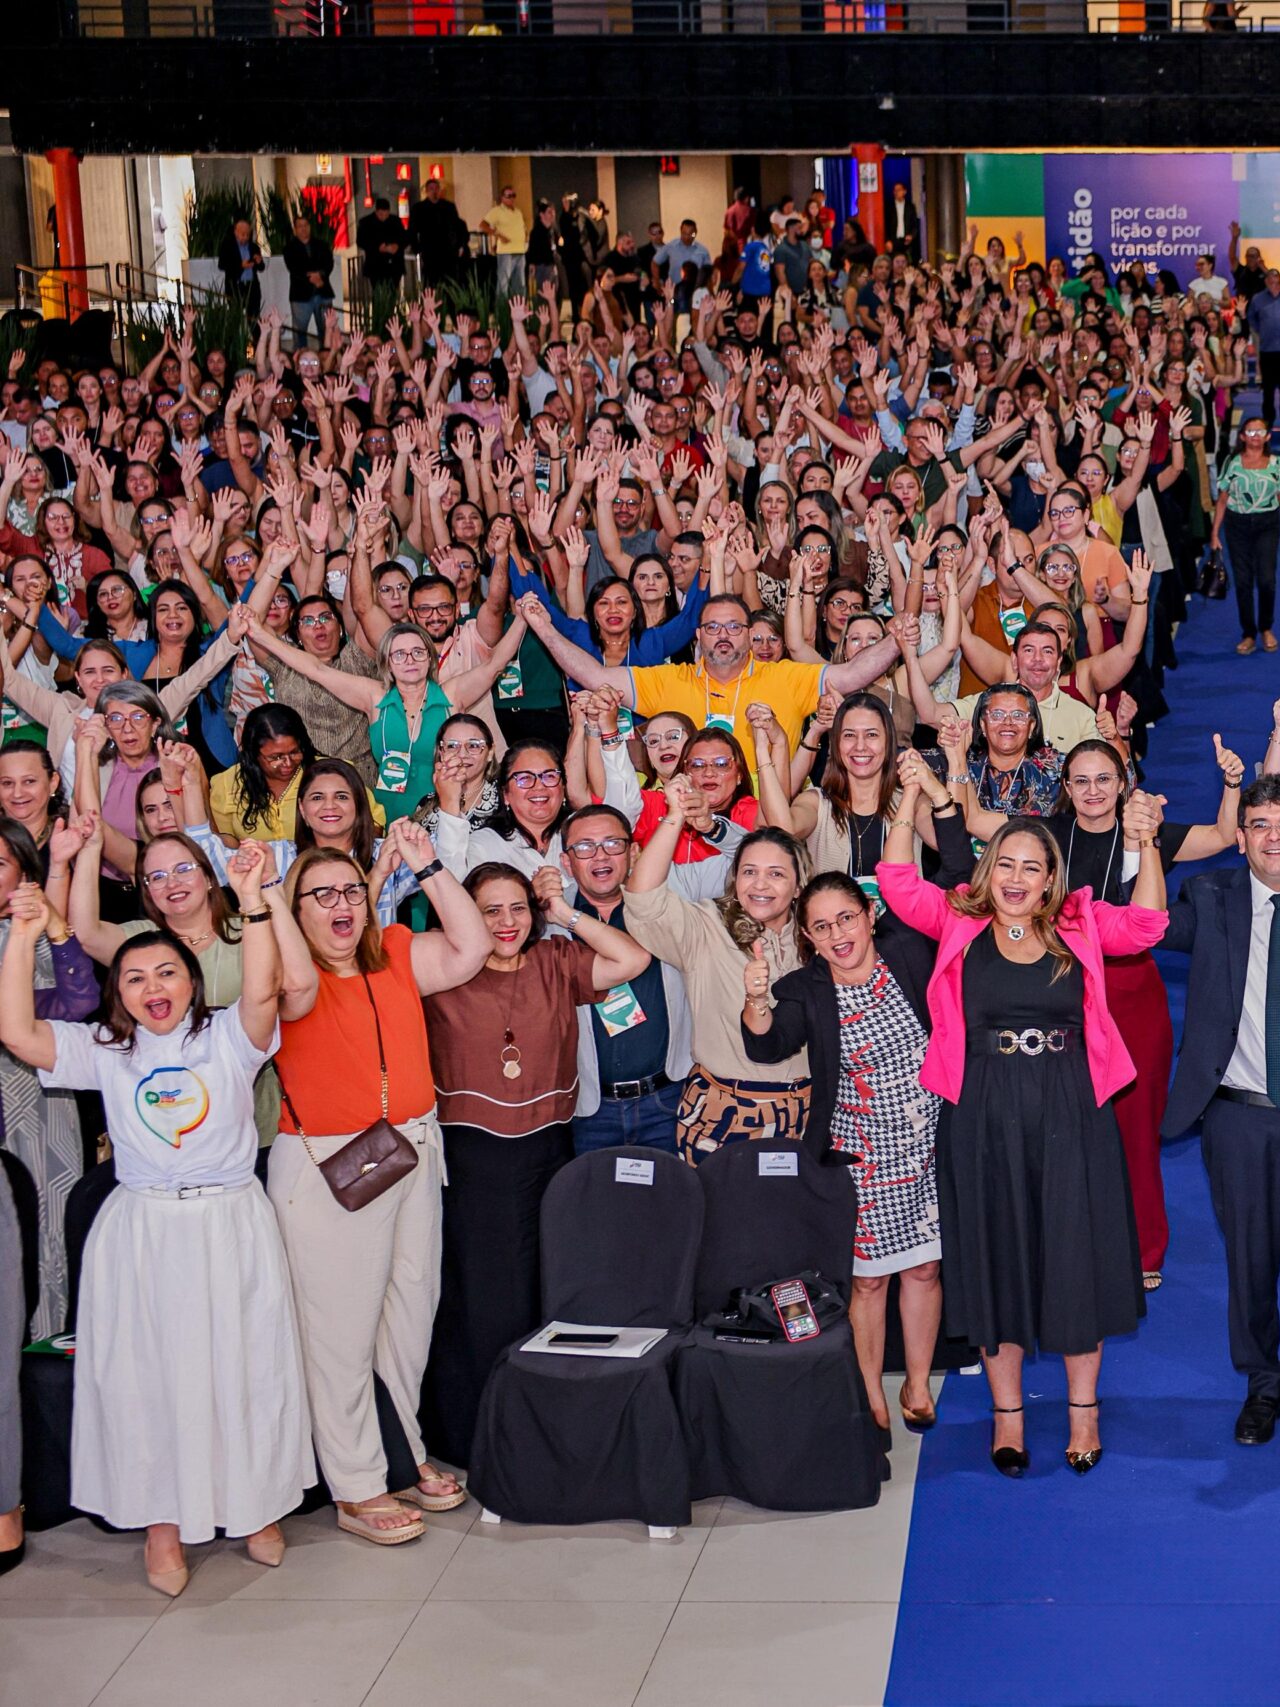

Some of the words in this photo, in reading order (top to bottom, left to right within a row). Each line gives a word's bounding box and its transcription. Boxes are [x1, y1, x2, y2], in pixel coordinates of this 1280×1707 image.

[1110, 206, 1141, 222] por
[1145, 204, 1188, 220] cada
[1068, 188, 1093, 275] tidão
[1110, 222, 1152, 242] lição
[1156, 225, 1168, 238] e
[1171, 225, 1203, 241] por
[1110, 239, 1216, 257] transformar
[1110, 257, 1161, 274] vis.
